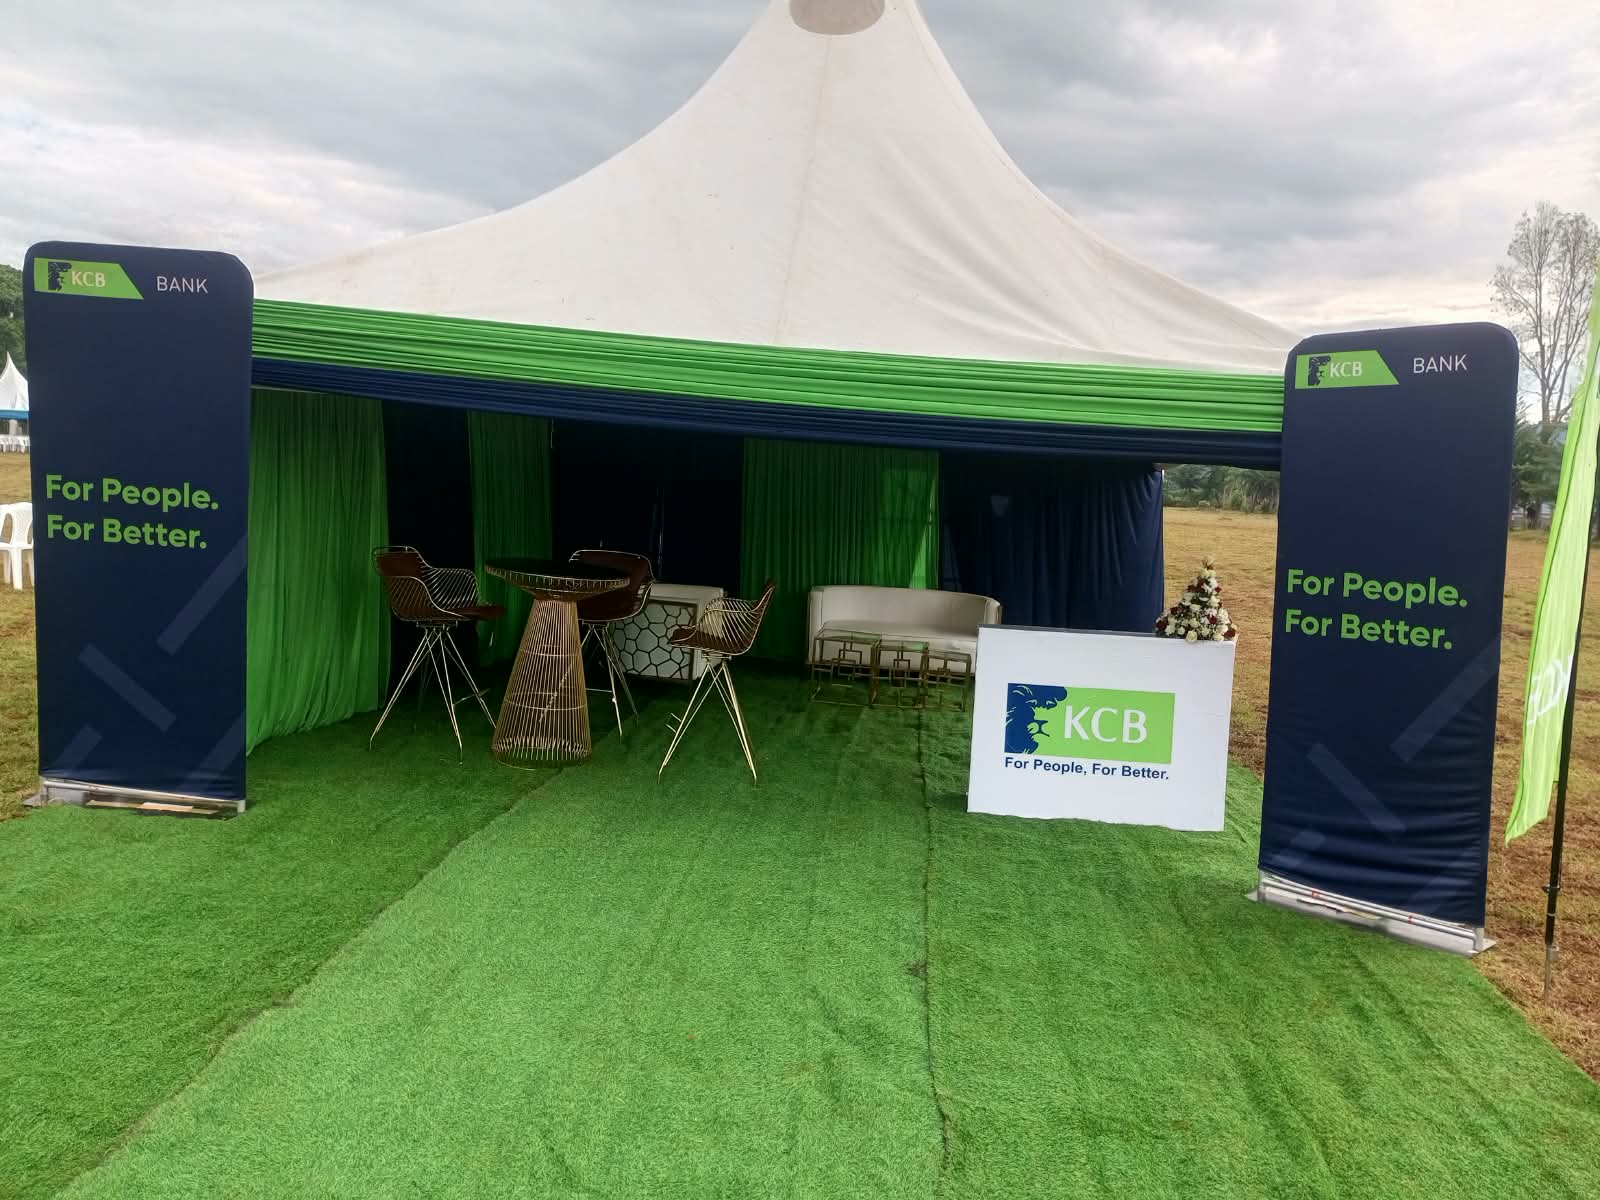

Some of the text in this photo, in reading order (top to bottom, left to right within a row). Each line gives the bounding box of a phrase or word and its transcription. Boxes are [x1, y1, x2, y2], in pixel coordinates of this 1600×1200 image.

[71, 270, 209, 294] KCB BANK
[1330, 354, 1468, 377] KCB BANK
[46, 474, 219, 512] For People.
[47, 515, 207, 549] For Better.
[1287, 569, 1468, 609] For People.
[1285, 609, 1453, 650] For Better.
[1063, 704, 1147, 744] KCB
[1005, 757, 1169, 780] For People, For Better.
